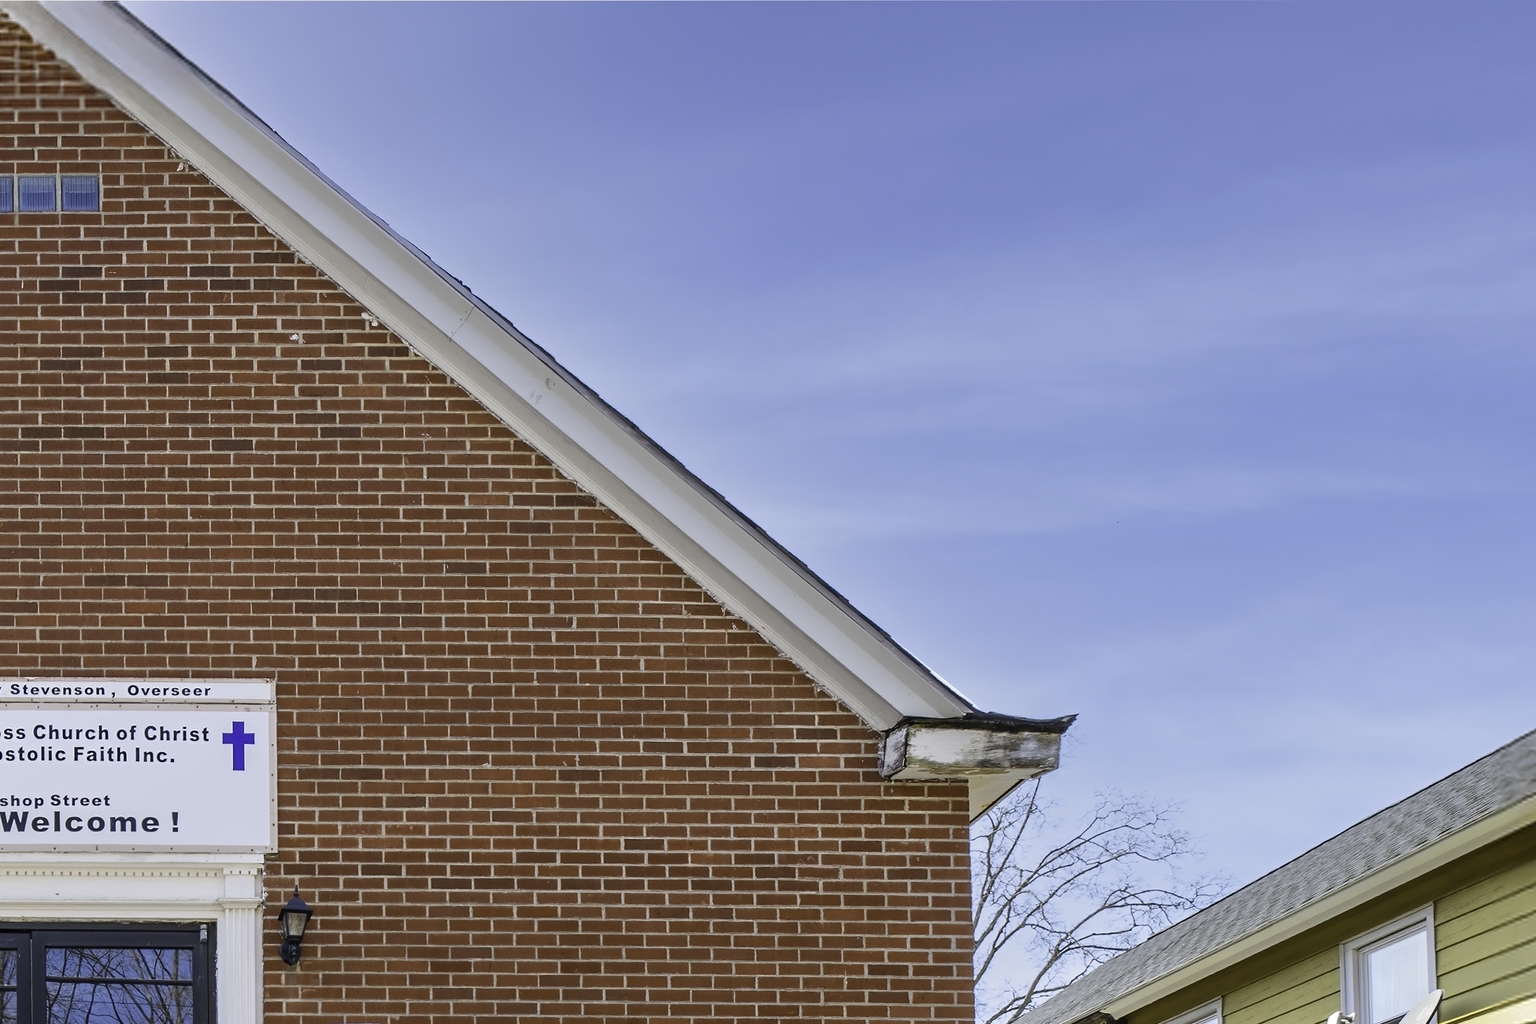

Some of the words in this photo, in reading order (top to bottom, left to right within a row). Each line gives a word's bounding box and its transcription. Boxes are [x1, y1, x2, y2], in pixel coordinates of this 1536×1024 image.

[10, 683, 105, 696] Stevenson
[127, 684, 211, 697] Overseer
[33, 725, 109, 741] Church
[116, 725, 137, 741] of
[144, 725, 210, 742] Christ
[73, 746, 128, 762] Faith
[135, 747, 175, 763] Inc.
[50, 794, 111, 807] Street
